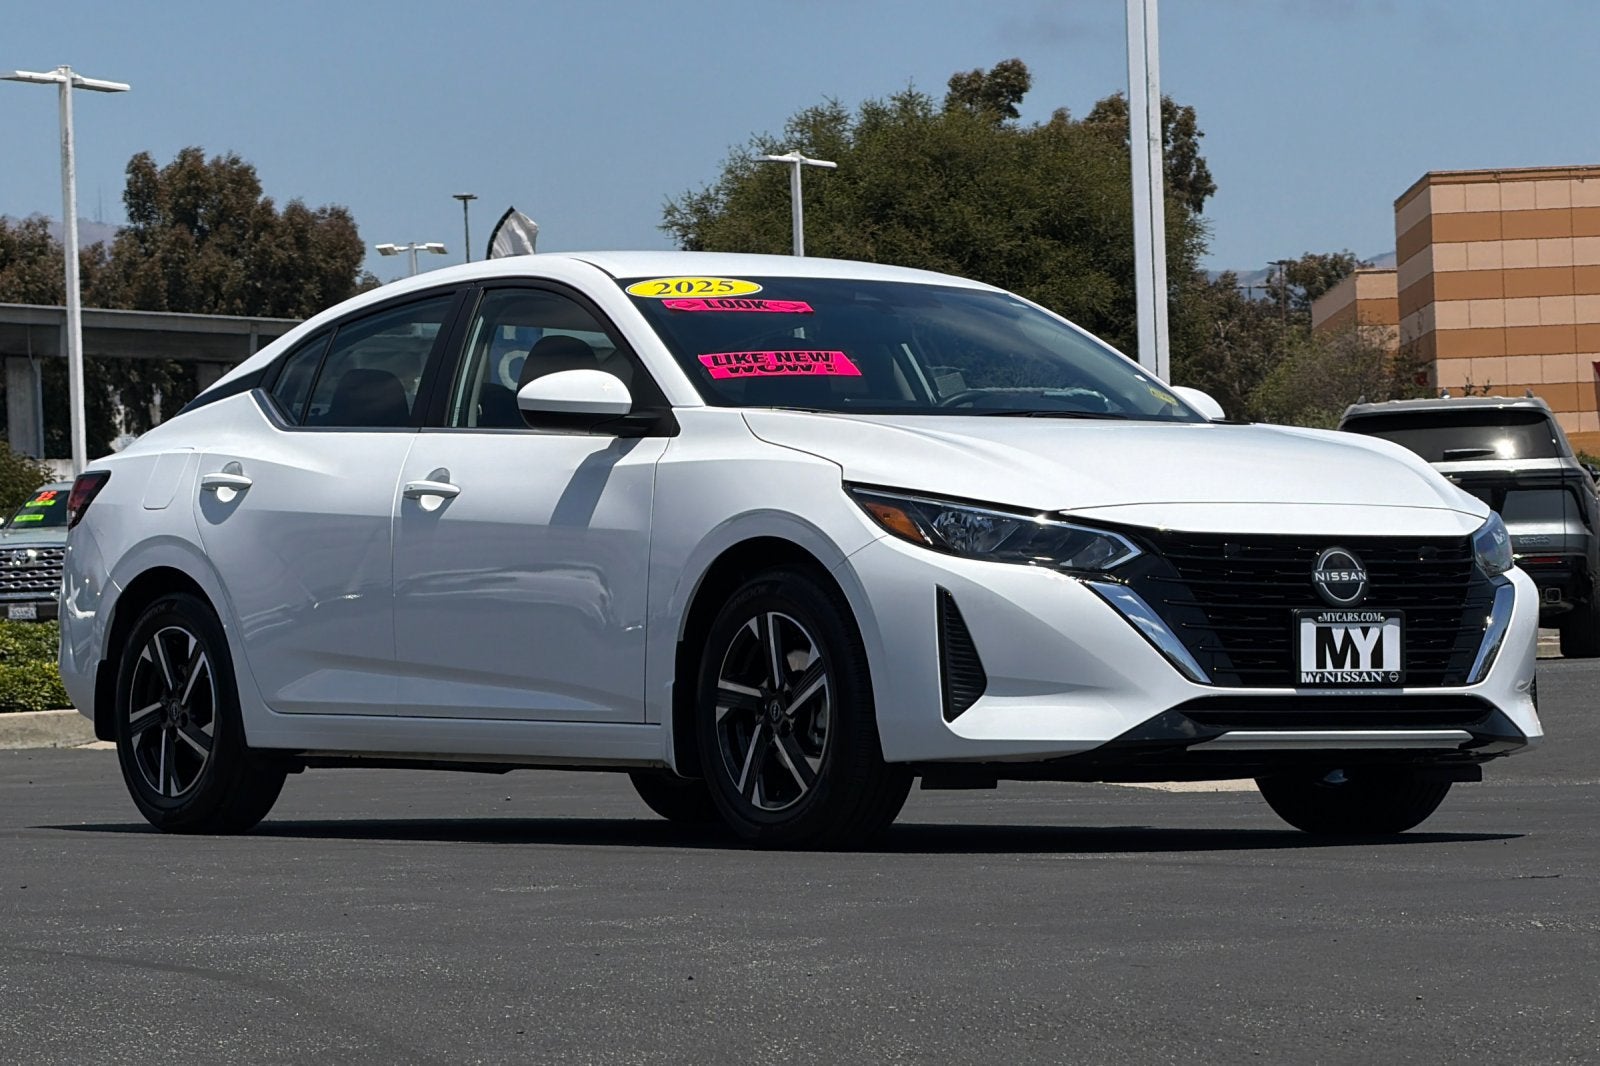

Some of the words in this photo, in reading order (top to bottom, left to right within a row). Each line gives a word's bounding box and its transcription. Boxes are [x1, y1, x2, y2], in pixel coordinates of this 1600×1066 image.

[654, 280, 735, 295] 2025
[702, 299, 769, 310] LOOK
[712, 353, 767, 367] LIKE
[775, 352, 832, 364] NEW
[1314, 571, 1367, 582] NISSAN
[1322, 612, 1382, 622] MYCARS.COM
[1315, 626, 1383, 669] MY
[1323, 671, 1383, 683] NISSAN
